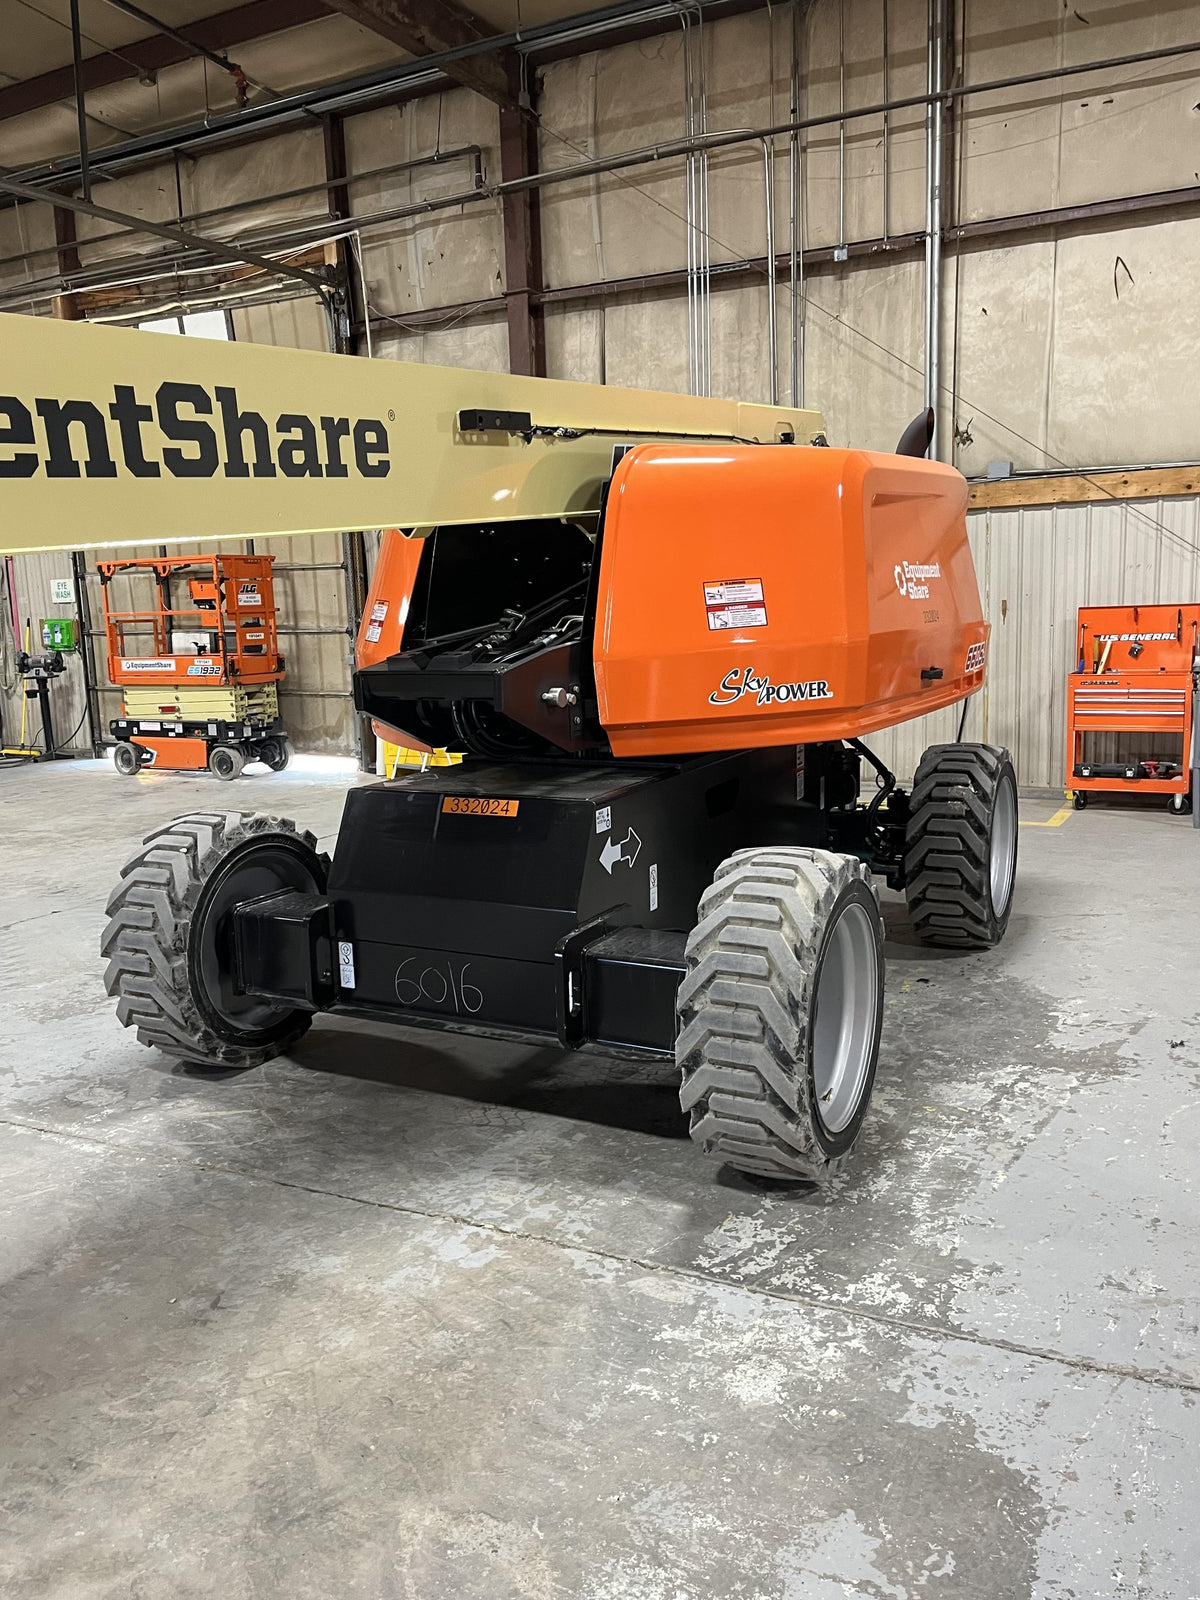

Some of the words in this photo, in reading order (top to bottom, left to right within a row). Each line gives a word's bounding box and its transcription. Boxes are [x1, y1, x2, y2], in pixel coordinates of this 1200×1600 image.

[902, 560, 941, 581] Equipment
[57, 581, 68, 590] EYE
[239, 584, 257, 593] JLG
[55, 591, 71, 599] WASH
[907, 582, 930, 599] Share
[1119, 633, 1177, 641] GENERAL
[131, 661, 172, 669] EquipmentShare
[188, 666, 221, 675] ES1932
[449, 797, 510, 816] 332024
[394, 956, 484, 1014] 6016
